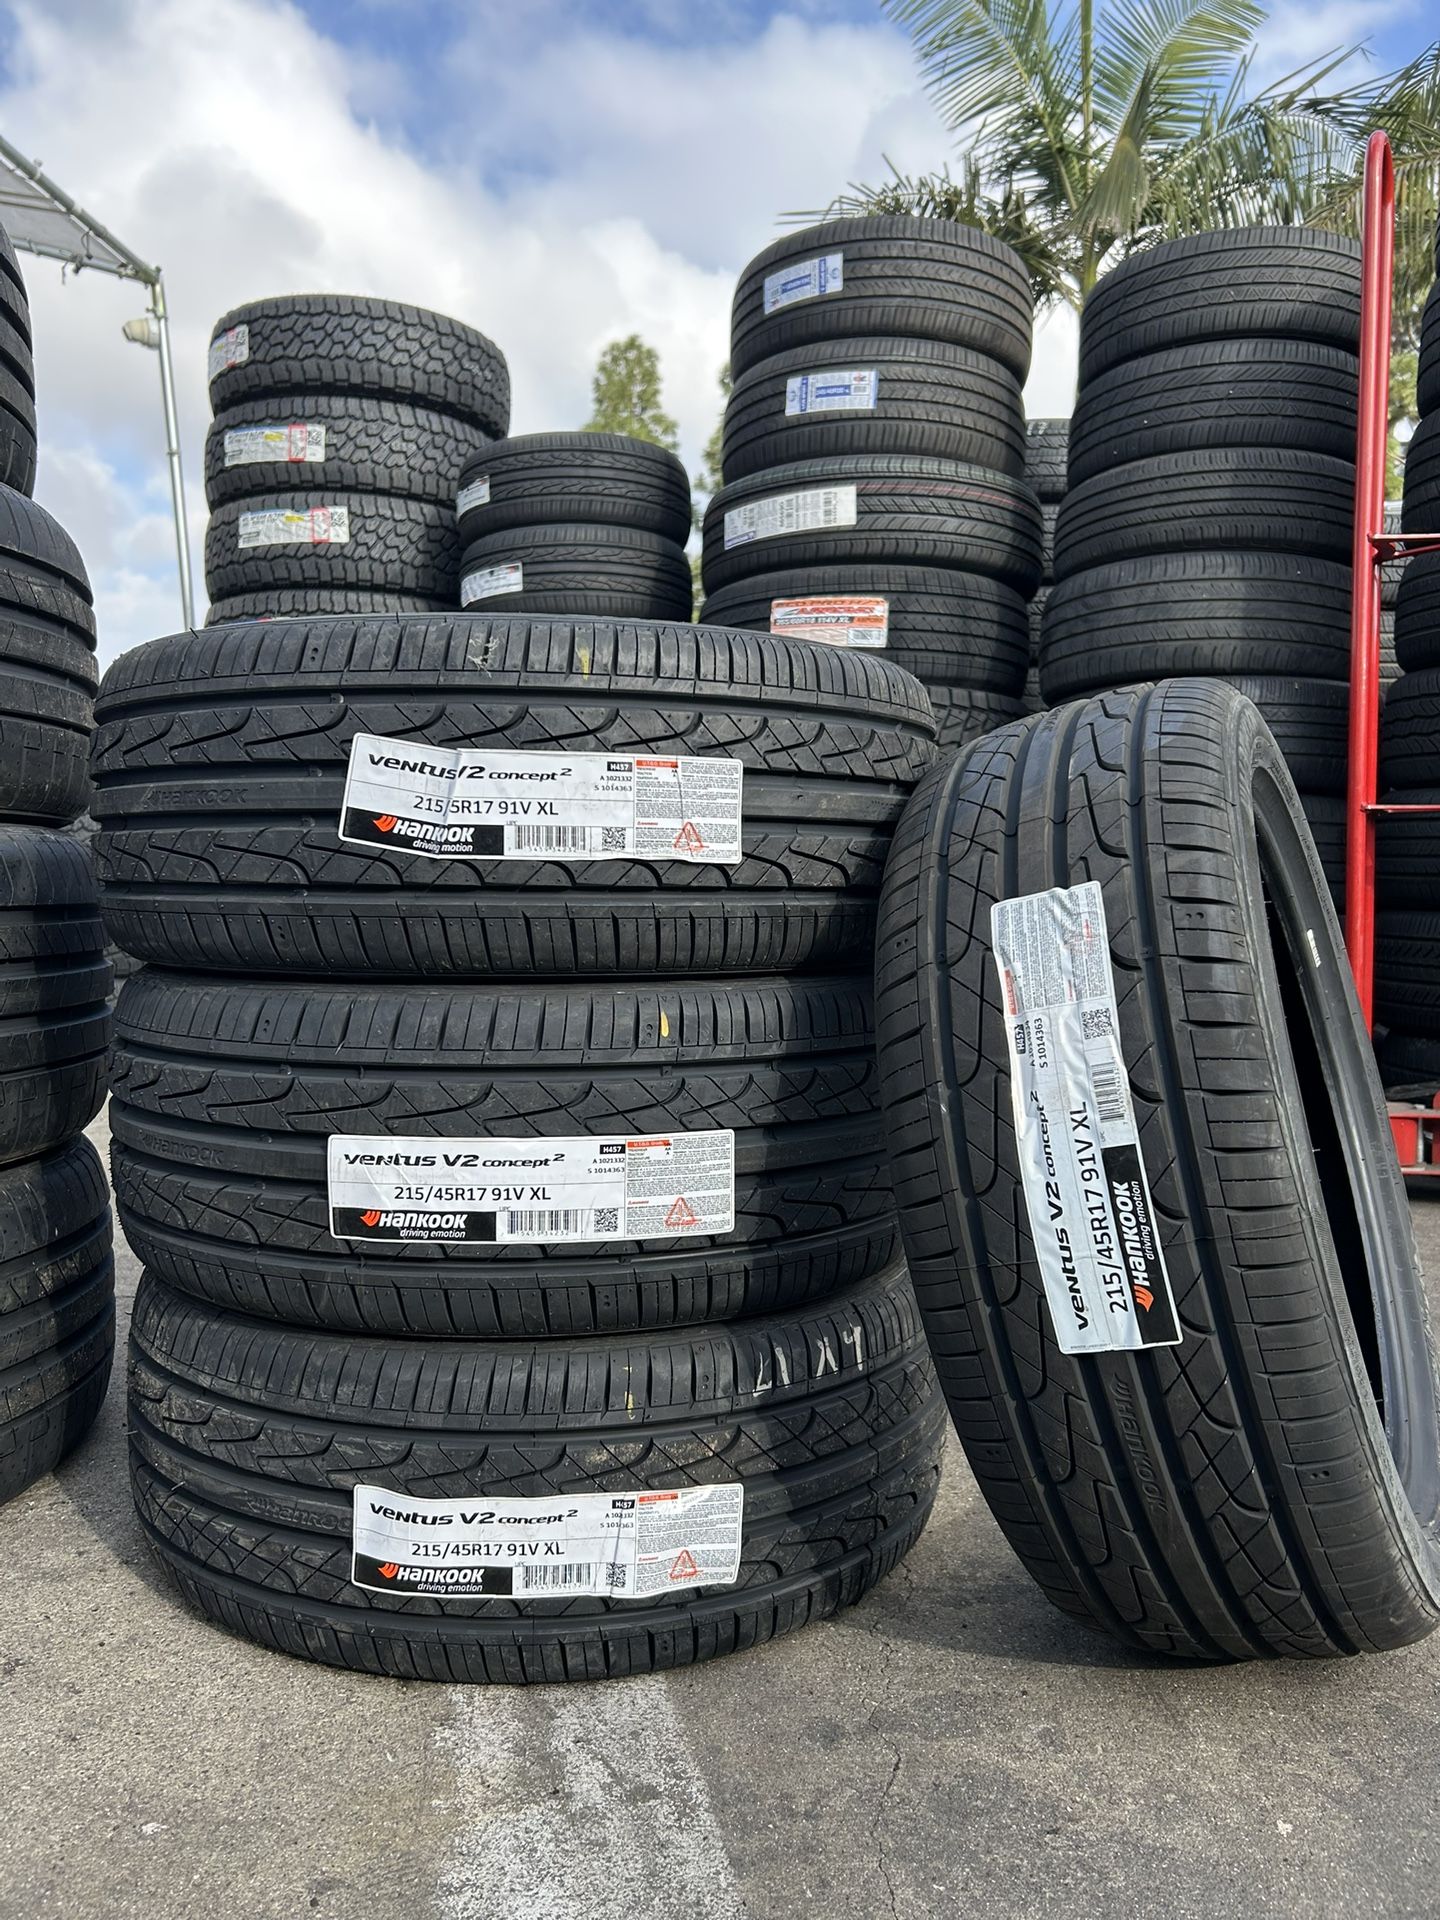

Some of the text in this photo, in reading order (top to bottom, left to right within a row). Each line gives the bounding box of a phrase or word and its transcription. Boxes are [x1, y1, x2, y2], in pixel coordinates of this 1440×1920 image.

[499, 800, 532, 815] 91V
[537, 800, 559, 815] XL
[412, 839, 441, 853] driving
[1016, 1027, 1026, 1052] H457
[1033, 1017, 1049, 1069] S 1014363
[1069, 1101, 1091, 1132] XL
[603, 1145, 622, 1153] H457
[443, 1153, 480, 1168] V2
[1074, 1138, 1100, 1182] 91V
[393, 1185, 551, 1204] 215/45R17 91V XL
[1046, 1181, 1064, 1222] V2
[1131, 1180, 1155, 1261] driving emotion
[399, 1228, 466, 1240] driving emotion
[1084, 1189, 1129, 1314] 215/45R17
[459, 1511, 495, 1525] V2
[411, 1541, 565, 1560] 215/45R17 91V XL
[417, 1582, 483, 1594] driving emotion
